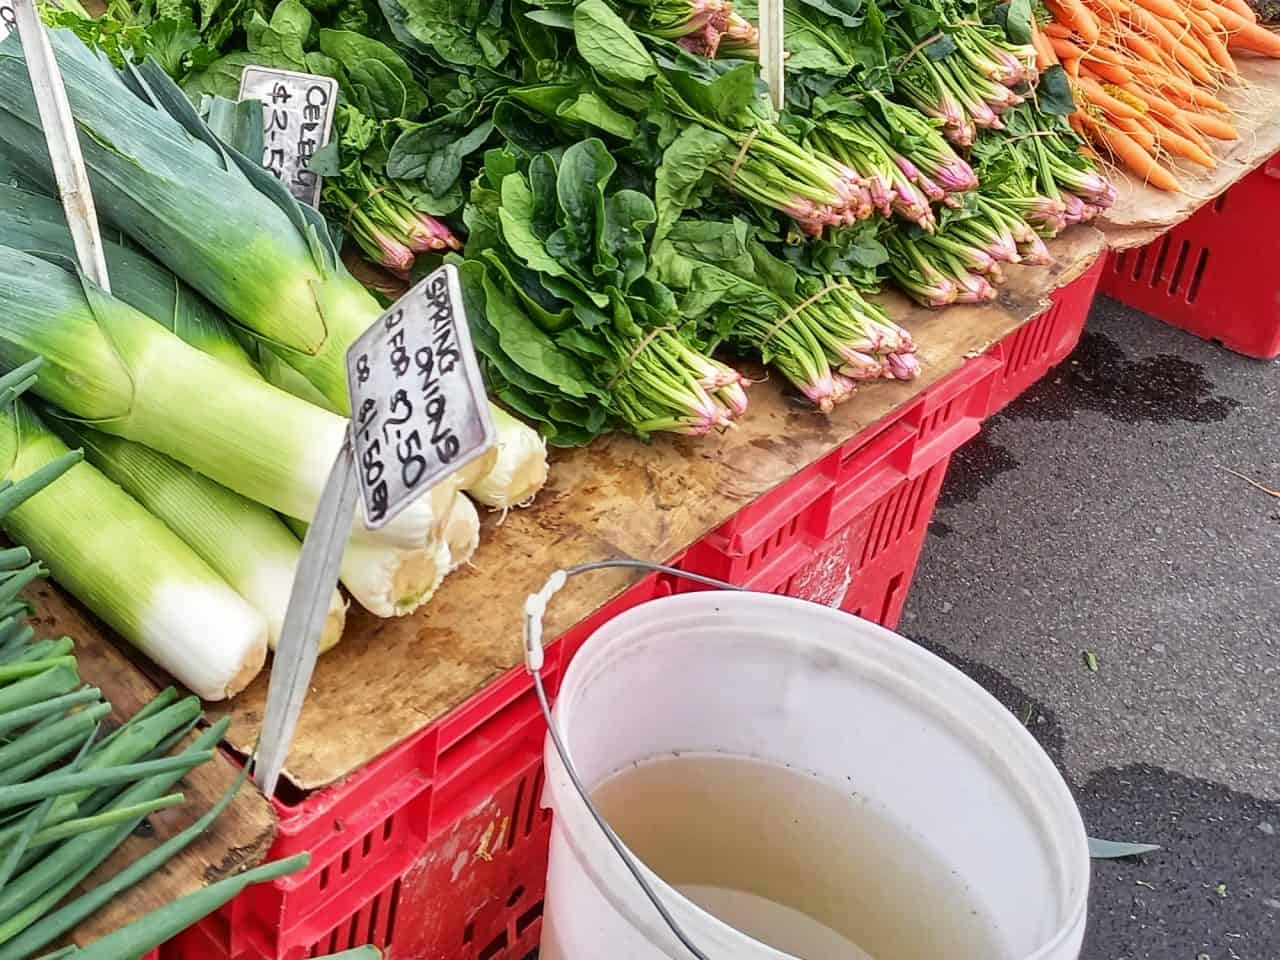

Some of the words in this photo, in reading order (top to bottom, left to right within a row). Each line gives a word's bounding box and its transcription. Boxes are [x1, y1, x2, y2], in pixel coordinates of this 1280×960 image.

[384, 309, 404, 332] 2
[387, 327, 411, 378] FOR
[425, 275, 460, 376] SPRING
[414, 346, 460, 464] ONIONS
